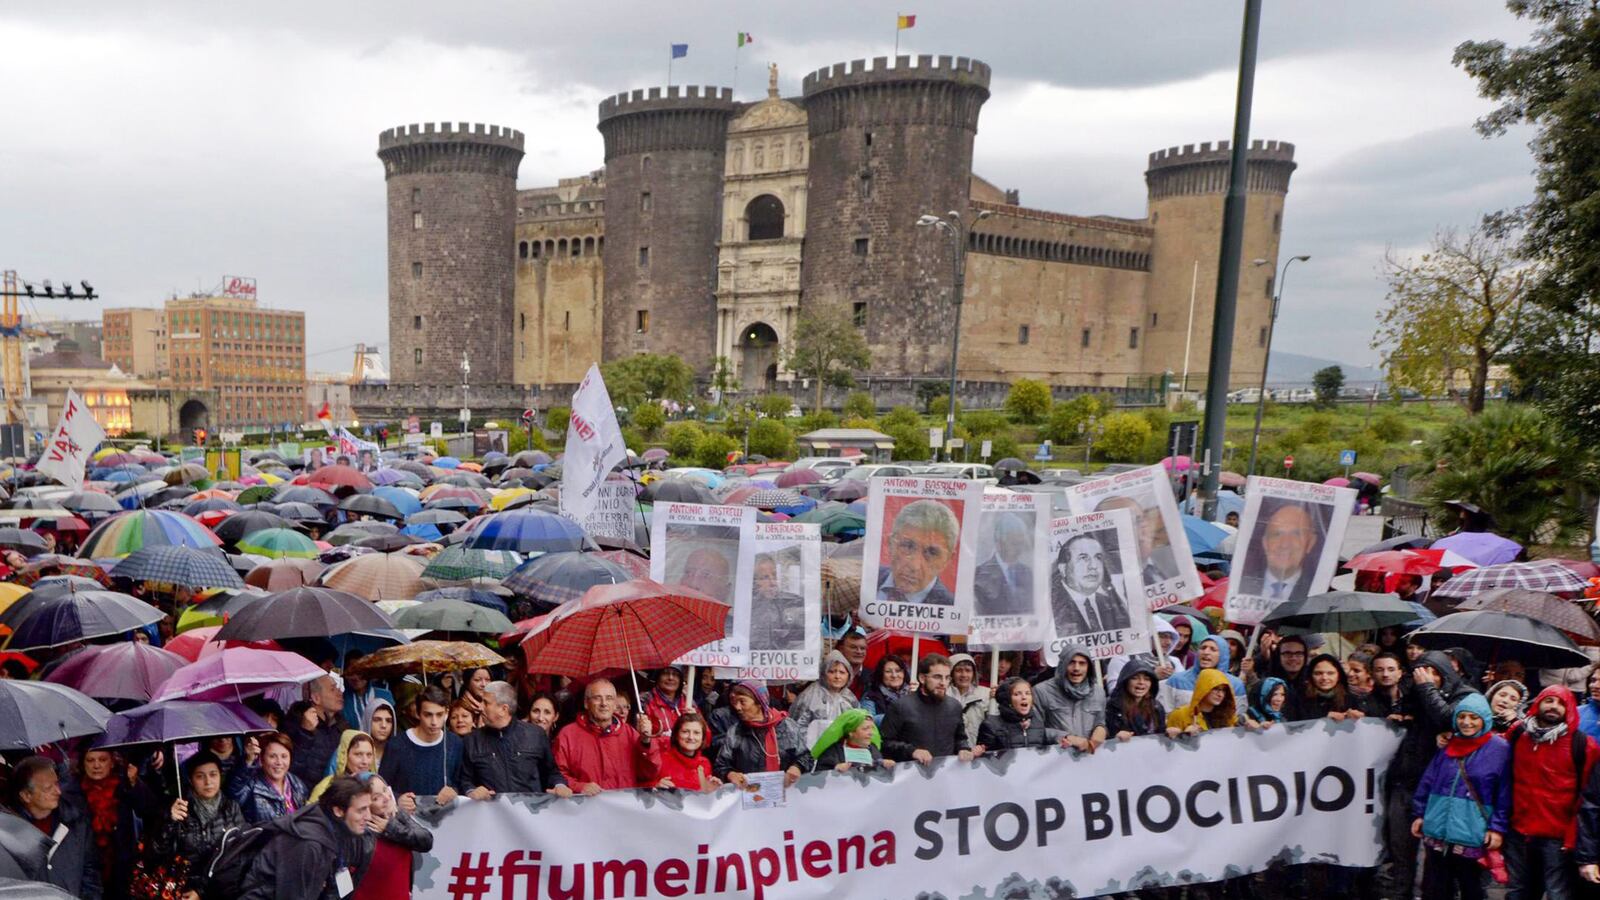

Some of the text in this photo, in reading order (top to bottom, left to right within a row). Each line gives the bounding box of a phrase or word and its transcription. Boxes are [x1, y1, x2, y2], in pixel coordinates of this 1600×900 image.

[884, 479, 918, 488] ANTONIO
[669, 504, 703, 515] ANTONIO
[1146, 583, 1167, 598] OLE
[1149, 593, 1178, 611] IDIO
[866, 602, 961, 620] COLPEVOLE DI
[884, 617, 940, 632] BIOCIDIO
[1095, 644, 1124, 657] IDIO
[750, 651, 798, 666] PEVOLE
[737, 667, 800, 681] BIOCIDIO
[448, 766, 1376, 900] #fiumeinpiena STOP BIOCIDIO!
